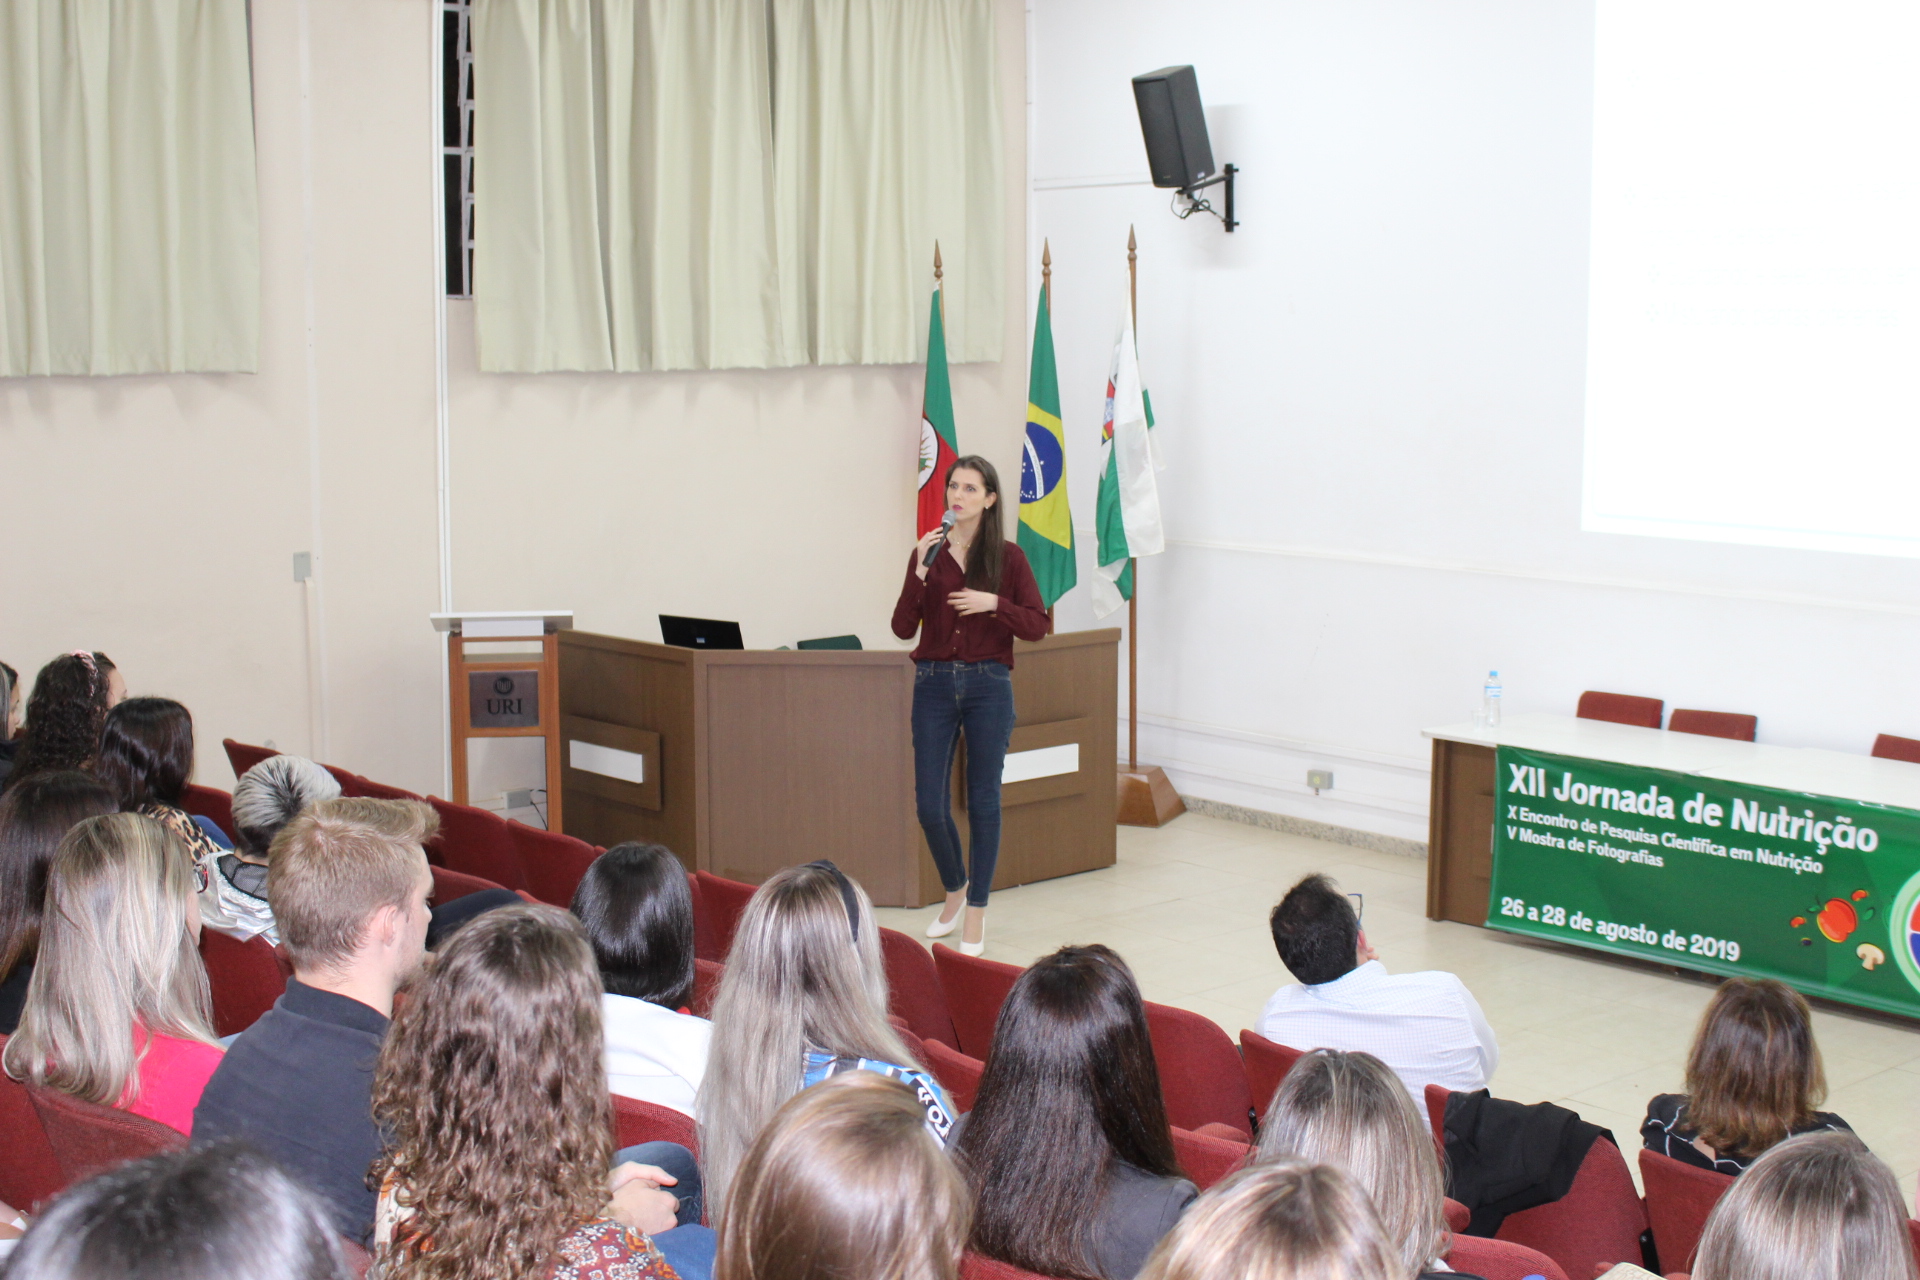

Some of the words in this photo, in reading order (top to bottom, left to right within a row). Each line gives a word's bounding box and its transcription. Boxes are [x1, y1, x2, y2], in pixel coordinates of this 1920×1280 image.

[486, 698, 522, 715] URI
[1507, 804, 1518, 820] X
[1519, 806, 1579, 831] Encontro
[1580, 818, 1599, 834] de
[1599, 820, 1660, 846] Pesquisa
[1661, 832, 1728, 858] Científica
[1729, 847, 1754, 862] em
[1756, 847, 1824, 875] Nutrição
[1508, 763, 1546, 798] XII
[1552, 771, 1676, 820] Jornada
[1682, 792, 1724, 828] de
[1731, 798, 1879, 856] Nutrição
[1506, 825, 1518, 840] V
[1519, 827, 1566, 850] Mostra
[1567, 836, 1587, 853] de
[1587, 839, 1665, 868] Fotografias
[1500, 896, 1525, 919] 26
[1527, 906, 1540, 922] a
[1541, 904, 1567, 927] 28
[1569, 911, 1594, 933] de
[1595, 920, 1659, 946] agosto
[1661, 929, 1688, 952] de
[1689, 934, 1741, 962] 2019
